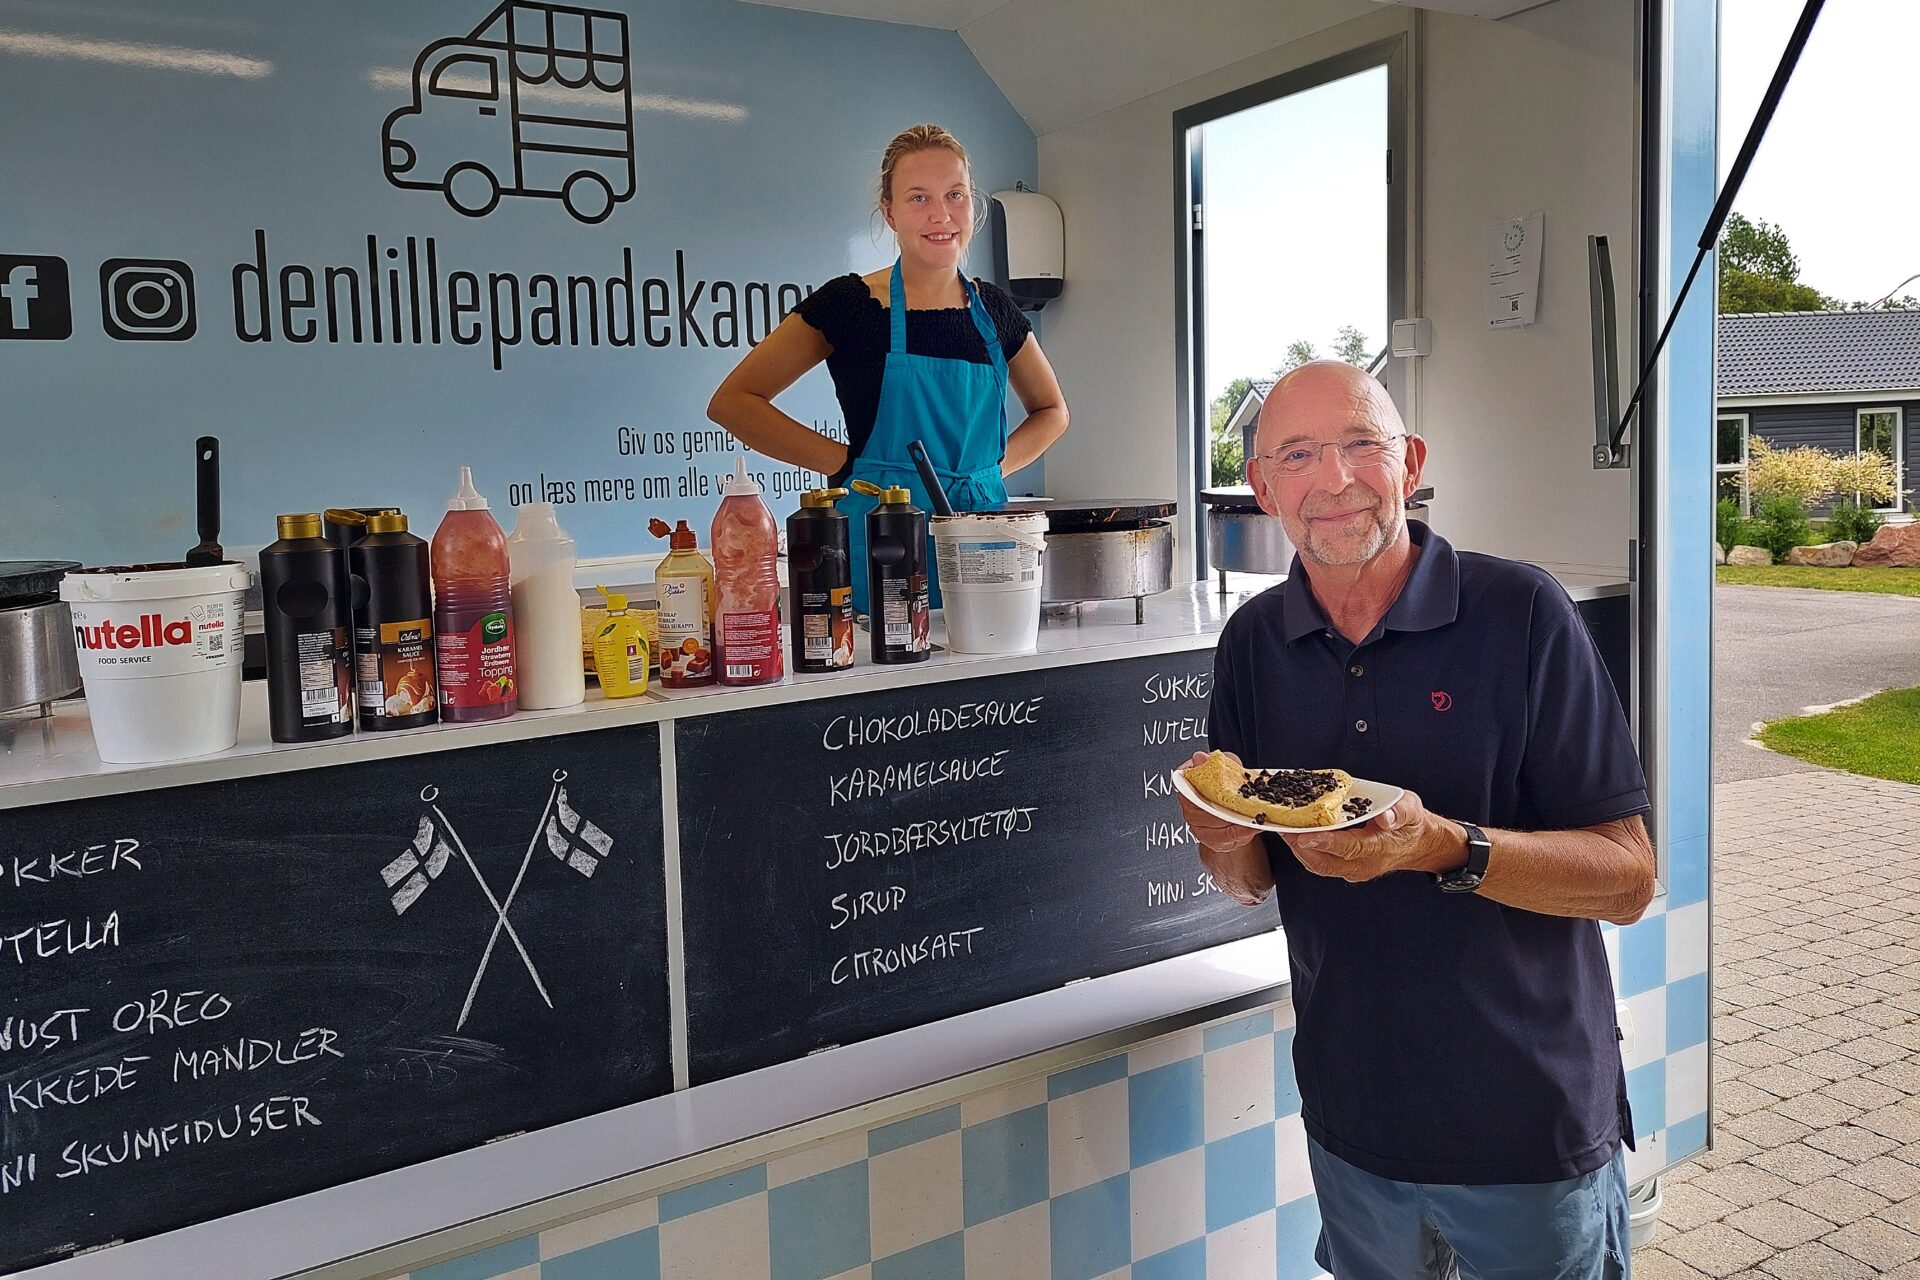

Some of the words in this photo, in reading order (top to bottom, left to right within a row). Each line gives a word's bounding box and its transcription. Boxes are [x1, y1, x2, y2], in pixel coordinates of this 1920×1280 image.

[231, 228, 812, 371] denlillepandekage
[617, 427, 646, 456] Giv
[653, 431, 675, 454] os
[682, 430, 735, 460] gerne
[540, 473, 576, 504] læs
[584, 478, 635, 502] mere
[643, 476, 670, 499] om
[678, 466, 708, 497] alle
[772, 466, 812, 500] gode
[74, 614, 192, 650] nutella
[198, 620, 225, 631] nutella
[98, 657, 117, 665] FOOD
[119, 655, 152, 664] SERVICE
[397, 645, 423, 653] KARAMEL
[402, 651, 420, 659] SAUCE
[478, 665, 513, 678] Topping
[1142, 672, 1214, 704] SUKKE
[823, 696, 1044, 751] CHOKOLADESAUCE
[829, 749, 1010, 807] KARAMELSAUCE
[0, 838, 142, 888] KKER
[830, 885, 906, 930] SIRUP
[1148, 880, 1184, 907] MINI
[1192, 872, 1222, 897] SK
[0, 910, 119, 964] TELLA
[830, 926, 985, 986] CITRONSAFT
[112, 989, 232, 1034] OREO
[173, 1026, 345, 1083] MANDLER
[56, 1096, 323, 1178] SKUMFIDUSER
